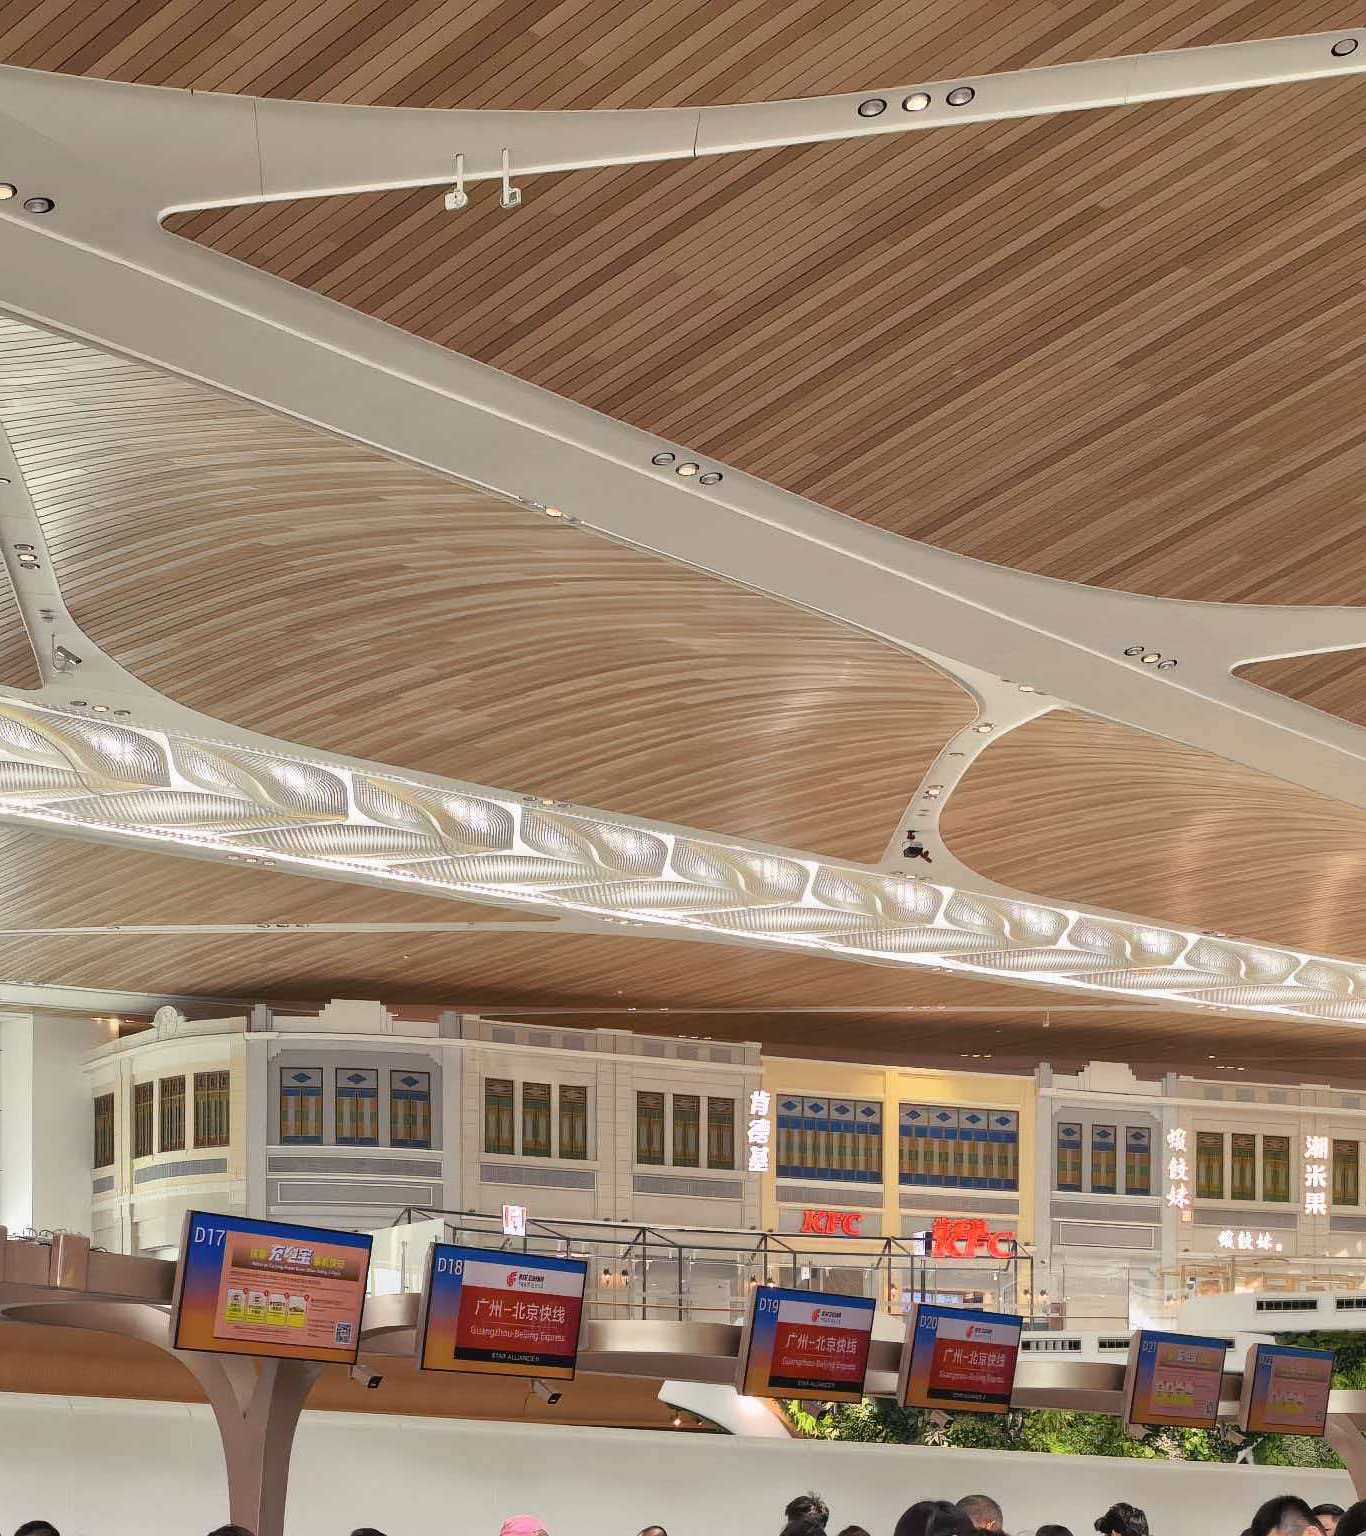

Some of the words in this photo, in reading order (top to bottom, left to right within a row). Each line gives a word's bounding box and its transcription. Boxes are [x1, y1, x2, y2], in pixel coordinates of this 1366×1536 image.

[800, 1209, 863, 1236] KFC
[194, 1226, 226, 1246] D17
[931, 1231, 1017, 1259] KFC
[437, 1257, 463, 1276] D18
[475, 1298, 566, 1324] 广州-北京快线
[759, 1297, 780, 1313] D19
[920, 1315, 938, 1329] D20
